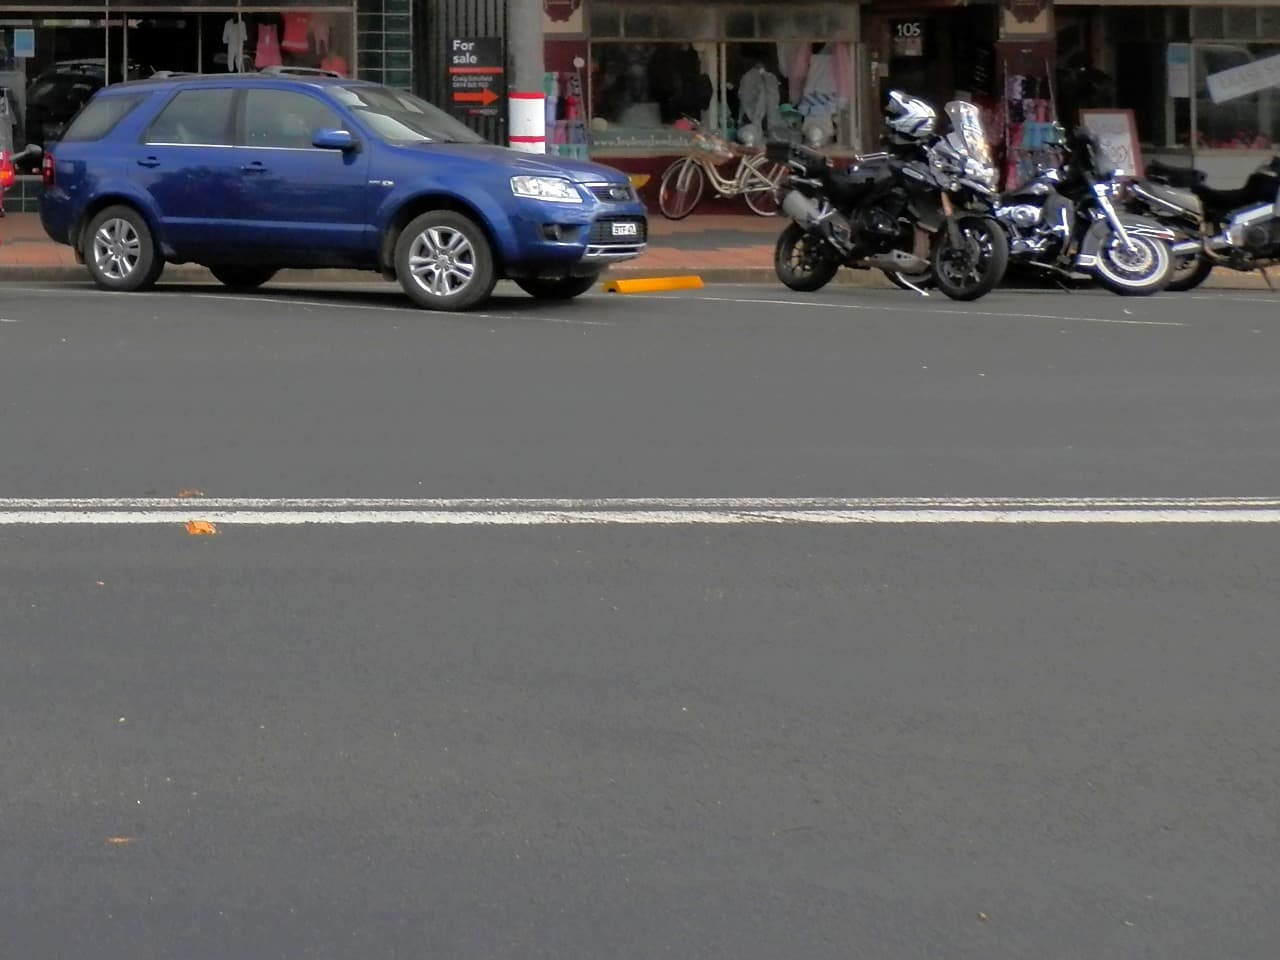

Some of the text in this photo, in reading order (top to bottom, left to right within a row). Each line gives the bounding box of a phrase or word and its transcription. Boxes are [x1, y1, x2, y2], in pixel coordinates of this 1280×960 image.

[896, 22, 921, 37] 105
[452, 40, 475, 51] For
[452, 52, 478, 64] sale
